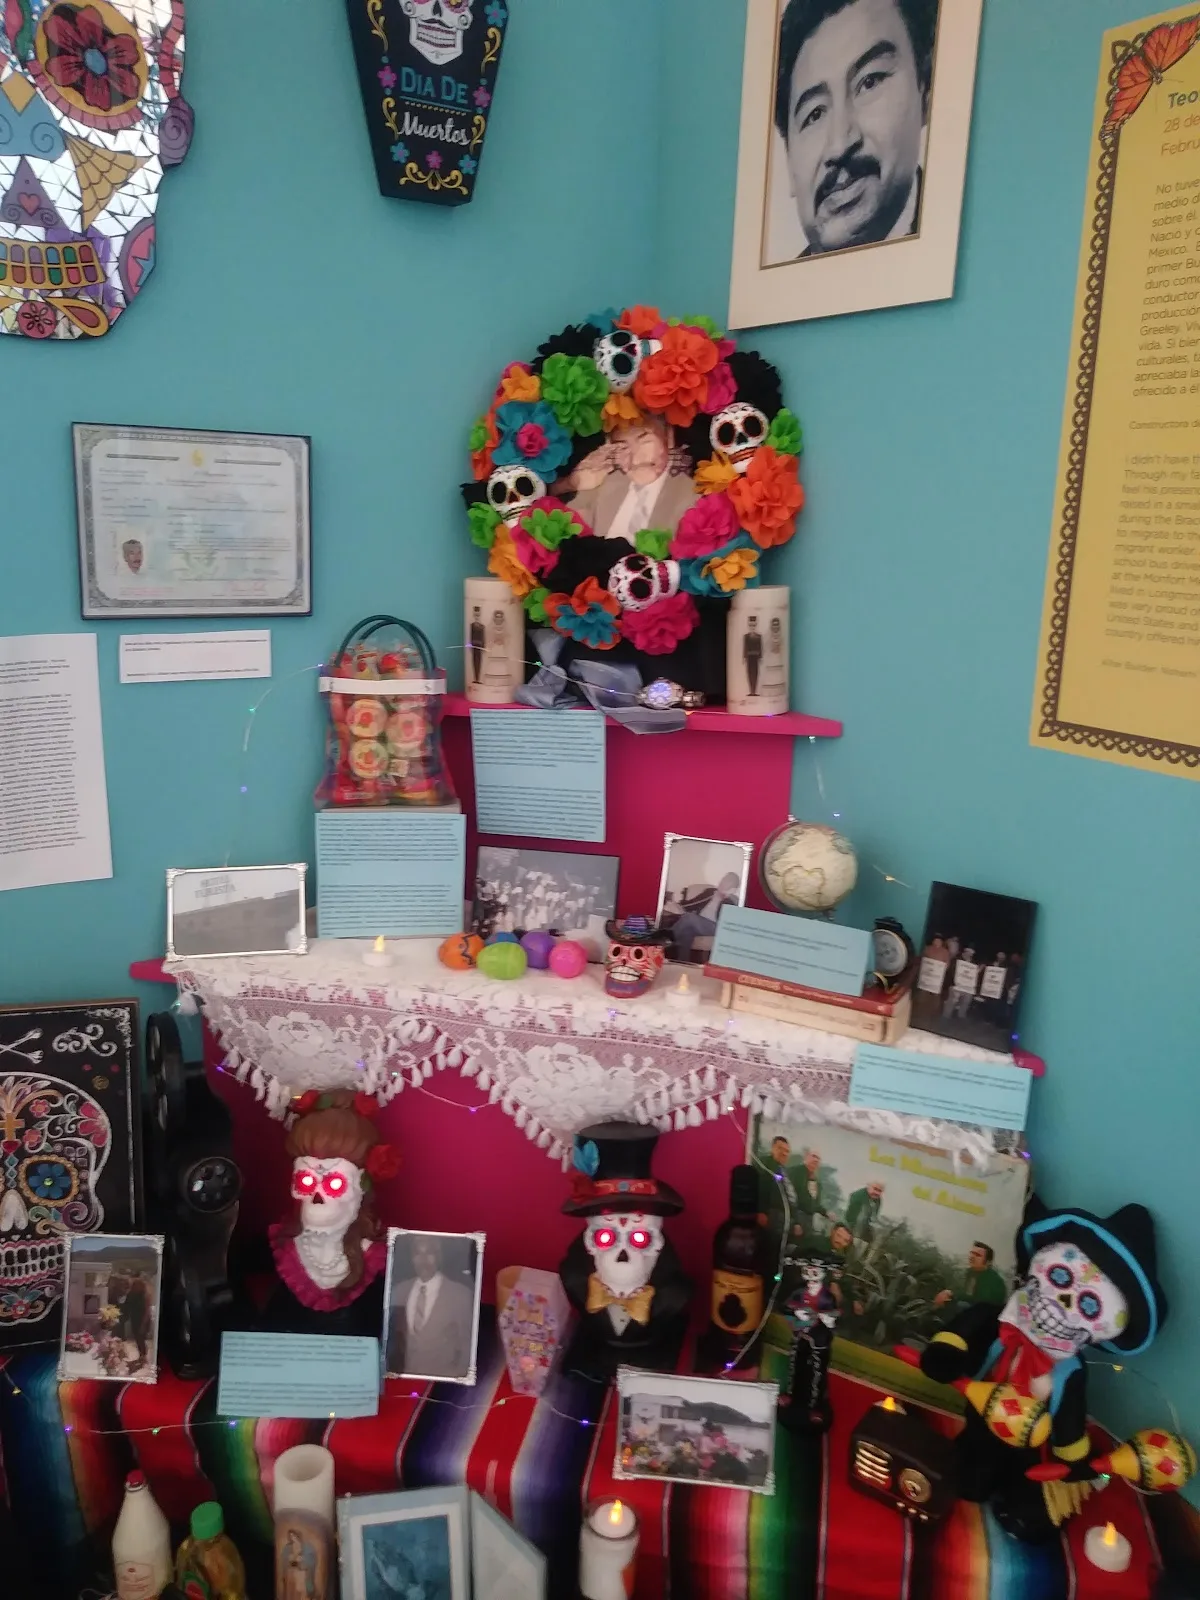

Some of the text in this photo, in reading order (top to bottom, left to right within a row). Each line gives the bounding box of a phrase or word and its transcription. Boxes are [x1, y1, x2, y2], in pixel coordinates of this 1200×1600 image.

[400, 66, 469, 104] DIA DE
[1168, 90, 1199, 109] Teo
[397, 111, 472, 146] Muertos
[1163, 112, 1200, 134] 28 de
[1155, 184, 1172, 195] No
[1153, 196, 1189, 212] medio
[1151, 213, 1183, 228] sobre
[1146, 261, 1183, 276] primer
[1144, 279, 1170, 291] duro
[1132, 384, 1177, 397] ofrecido
[1123, 469, 1166, 482] Through
